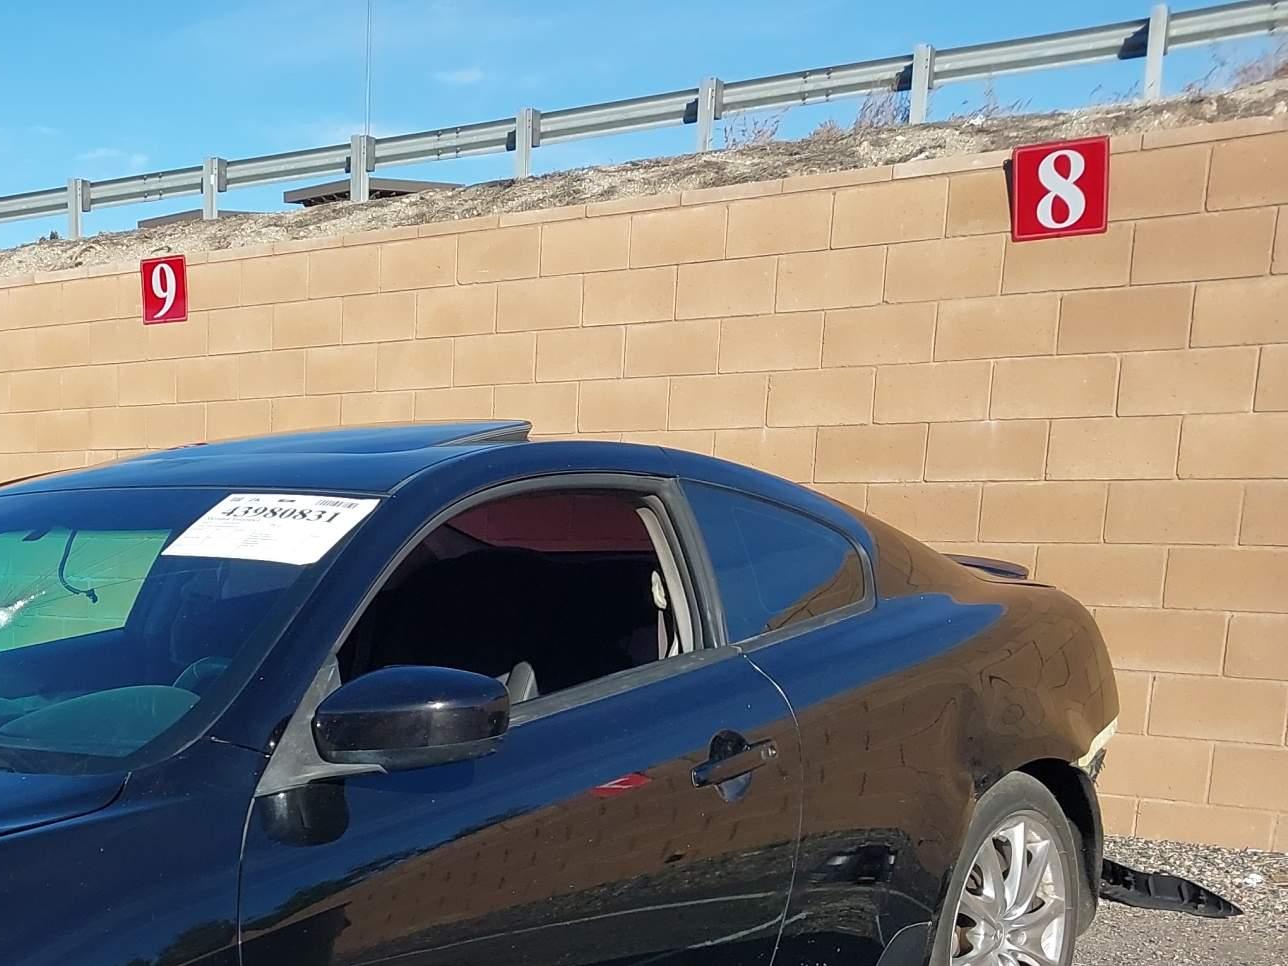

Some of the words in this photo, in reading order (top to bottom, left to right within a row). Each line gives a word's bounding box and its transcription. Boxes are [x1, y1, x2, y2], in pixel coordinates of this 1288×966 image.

[1036, 149, 1086, 229] 8
[152, 262, 177, 319] 9
[221, 506, 341, 523] 43980831
